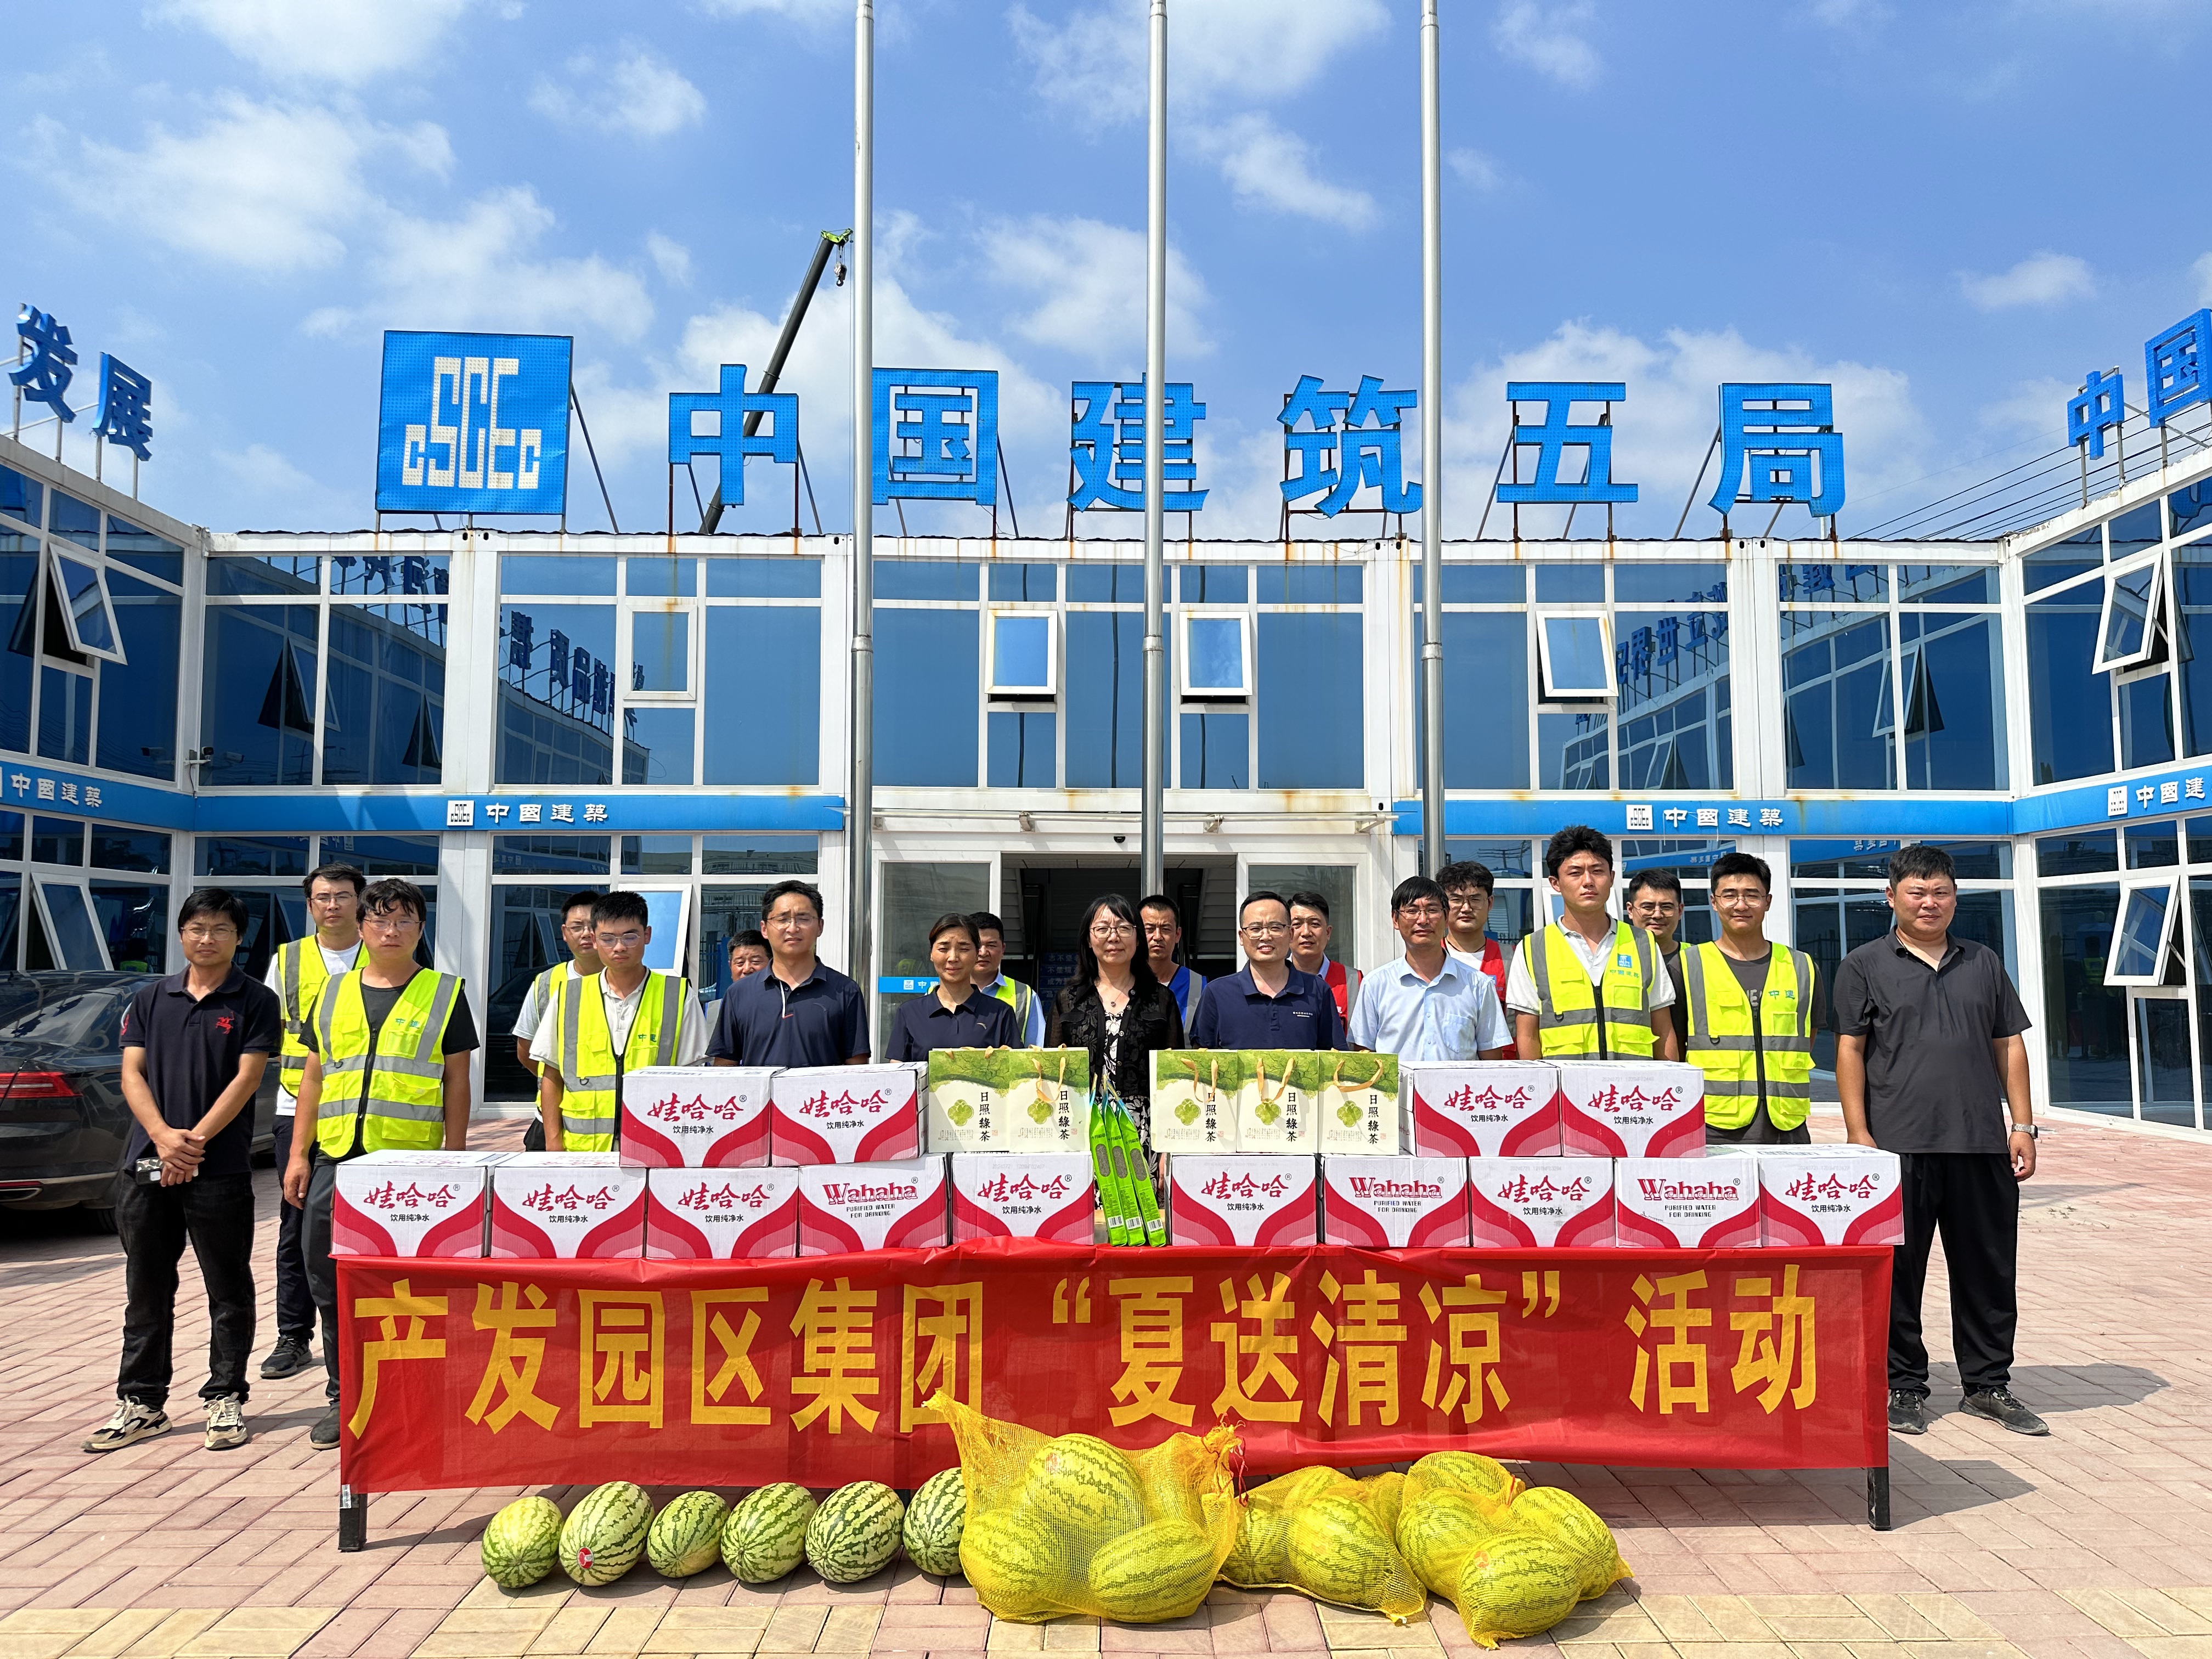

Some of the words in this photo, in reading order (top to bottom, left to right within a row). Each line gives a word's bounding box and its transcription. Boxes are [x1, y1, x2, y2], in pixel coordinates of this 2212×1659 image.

[8, 303, 154, 462] 发展
[2067, 308, 2212, 460] 中国
[668, 364, 1844, 519] 中国建筑五局
[10, 772, 103, 808] 中國建築
[2135, 776, 2212, 809] 中國建
[485, 802, 608, 823] 中國建築
[1663, 806, 1784, 827] 中國建築
[647, 1092, 744, 1122] 娃哈哈
[799, 1088, 889, 1116] 娃哈哈
[1444, 1084, 1532, 1112] 娃哈哈
[1588, 1084, 1681, 1113] 娃哈哈
[672, 1125, 714, 1135] 饮用纯净水
[826, 1120, 865, 1130] 饮用纯净水
[1470, 1114, 1509, 1122] 饮用纯净水
[1613, 1116, 1654, 1125] 饮用纯净水
[363, 1180, 457, 1209] 娃哈哈
[522, 1183, 616, 1212] 娃哈哈
[678, 1181, 771, 1211] 娃哈哈
[822, 1181, 918, 1205] Wahaha
[977, 1172, 1070, 1203] 娃哈哈
[1201, 1171, 1289, 1200] 娃哈哈
[1348, 1177, 1443, 1199] Wahaha
[1498, 1173, 1590, 1203] 娃哈哈
[1637, 1178, 1739, 1201] Wahaha
[1785, 1172, 1878, 1201] 娃哈哈
[390, 1213, 430, 1222] 饮用纯净水
[548, 1214, 589, 1223] 饮用纯净水
[704, 1214, 744, 1223] 饮用纯净水
[1002, 1205, 1042, 1215] 饮用纯净水
[1227, 1203, 1265, 1211] 饮用纯净水
[1522, 1206, 1563, 1216] 饮用纯净水
[1811, 1204, 1852, 1213] 饮用纯净水
[348, 1276, 983, 1440] 产发园区集团
[1051, 1267, 1561, 1427] “夏送清凉”
[1623, 1263, 1817, 1414] 活动
